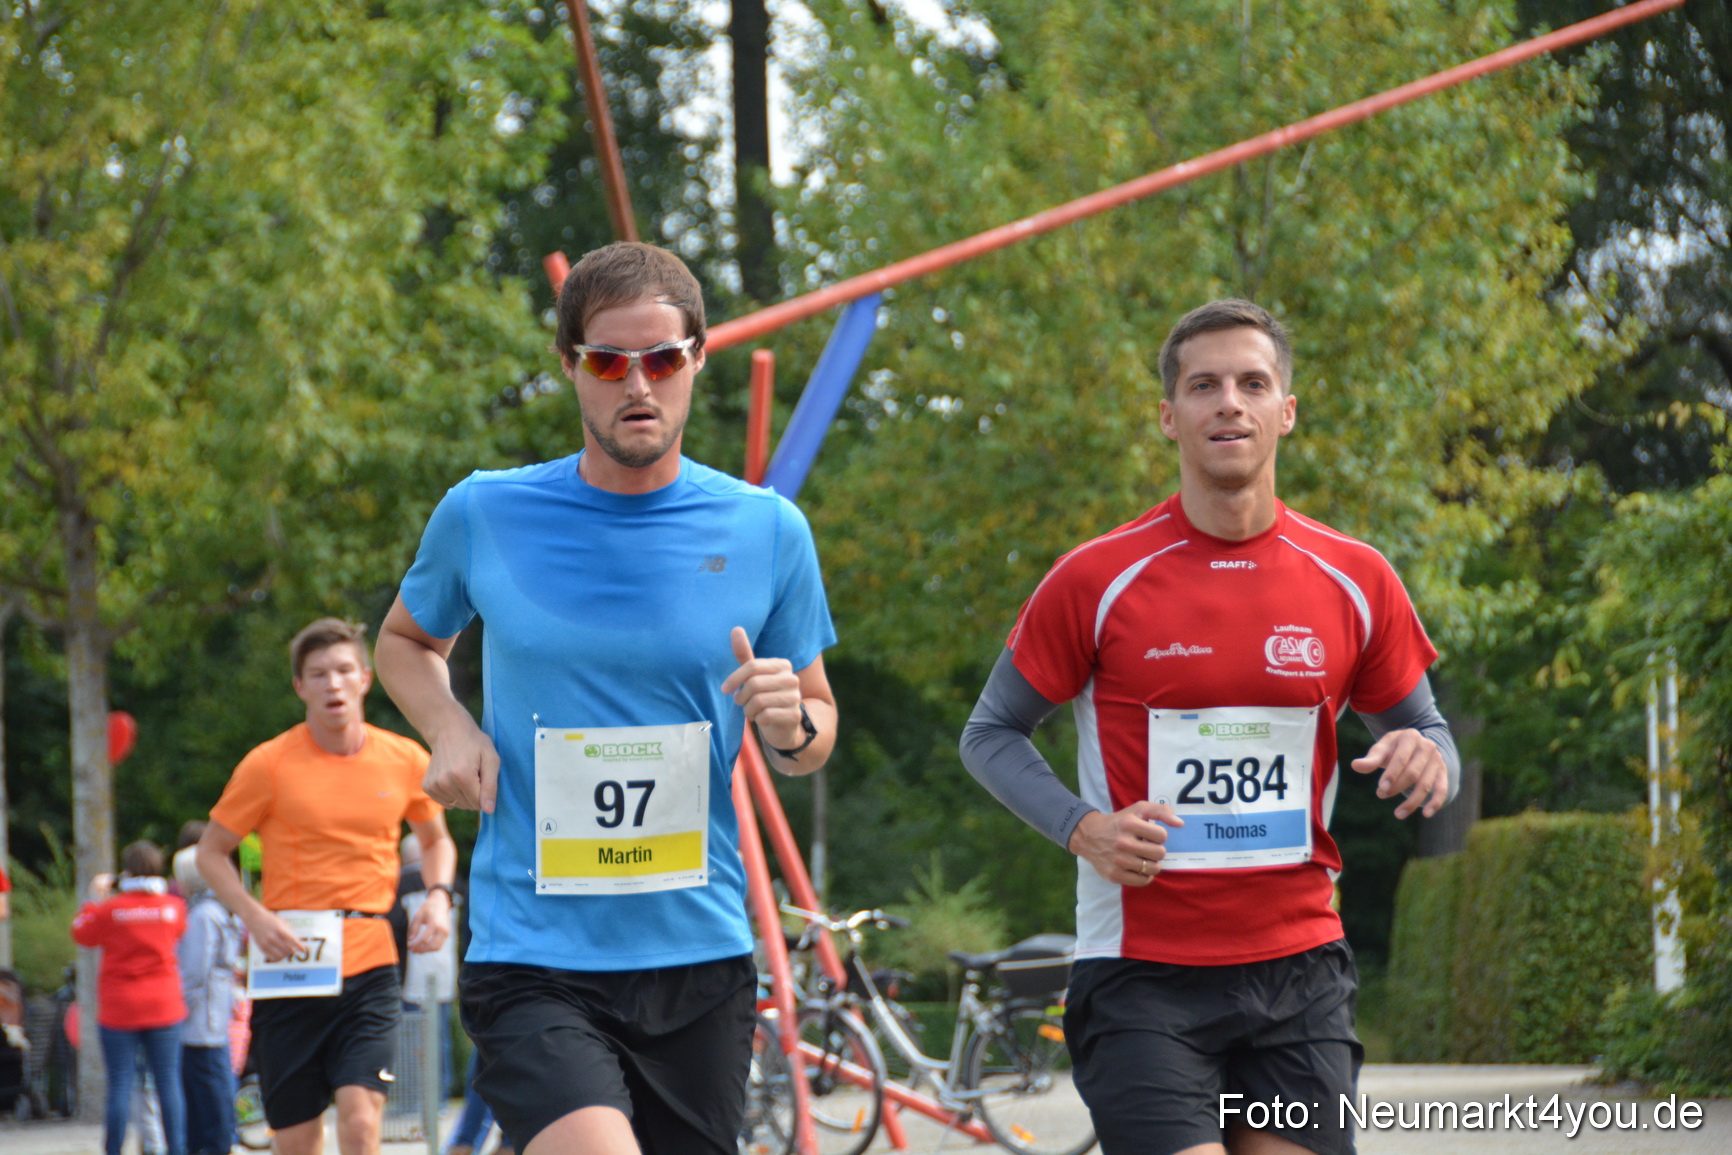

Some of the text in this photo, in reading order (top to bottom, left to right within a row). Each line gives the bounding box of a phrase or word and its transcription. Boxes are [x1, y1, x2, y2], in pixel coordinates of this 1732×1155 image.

[1210, 560, 1248, 569] CRAFT
[1273, 624, 1313, 634] Laufteam
[1214, 722, 1271, 737] BOCK
[602, 741, 663, 758] BOCK
[1175, 753, 1289, 806] 2584
[593, 779, 656, 829] 97
[545, 822, 552, 832] A
[1203, 823, 1267, 840] Thomas
[598, 846, 653, 865] Martin
